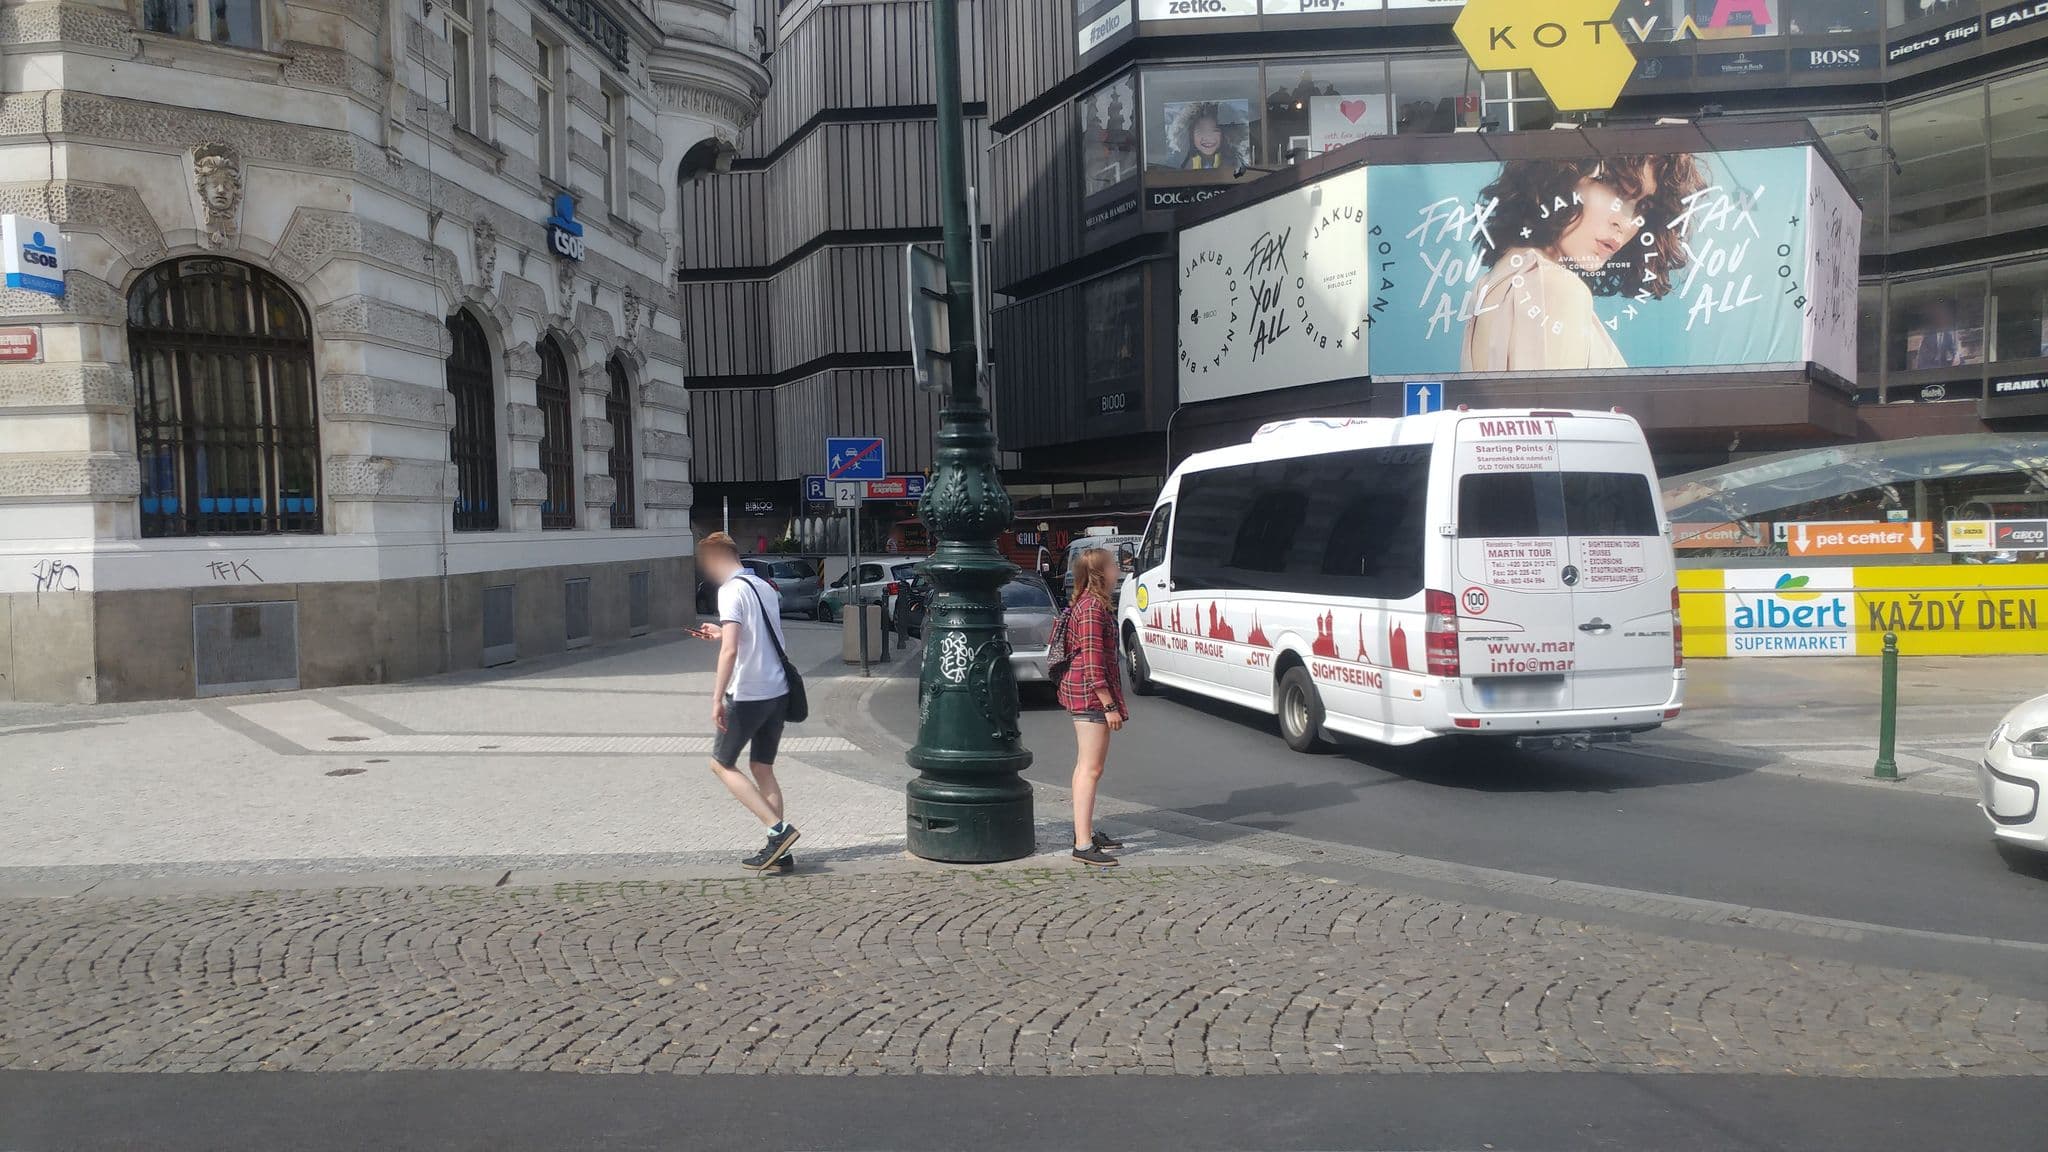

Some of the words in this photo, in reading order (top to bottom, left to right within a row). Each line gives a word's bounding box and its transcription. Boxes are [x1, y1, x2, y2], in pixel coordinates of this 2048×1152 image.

[1169, 0, 1226, 14] zetko.
[1089, 15, 1120, 45] #zetko
[1890, 36, 1940, 60] pietro
[1944, 23, 1979, 41] filipi
[1810, 49, 1860, 65] BOSS
[1154, 192, 1189, 205] DOLC
[1539, 192, 1624, 219] JAKB
[1666, 184, 1766, 238] FAX
[1313, 206, 1364, 239] JAKUB
[1405, 196, 1499, 249] FAX
[23, 248, 58, 269] ČSOB
[1243, 226, 1291, 281] FAX
[1419, 247, 1487, 309] YOU
[1679, 238, 1751, 300] YOU
[1185, 250, 1223, 278] JAKUB
[1213, 264, 1238, 367] POLANKA
[1249, 276, 1284, 335] YOU
[1296, 277, 1328, 349] BIBLOO
[1425, 284, 1500, 340] ALL
[1685, 274, 1763, 332] ALL
[1252, 308, 1290, 362] ALL
[1996, 379, 2039, 392] FRANK
[1479, 420, 1542, 437] MARTIN
[1545, 420, 1554, 435] T
[1475, 445, 1513, 453] Starting
[1515, 444, 1544, 452] Points
[1680, 531, 1702, 541] pet
[1817, 531, 1844, 548] pet
[1848, 530, 1904, 546] center
[2012, 530, 2044, 540] GECO
[1488, 549, 1525, 558] MARTIN
[1528, 549, 1552, 557] TOUR
[1466, 592, 1485, 606] 100
[1734, 598, 1848, 629] albert
[1869, 593, 1966, 632] KAŽDÝ
[1978, 598, 2038, 631] DEN
[1488, 641, 1575, 655] www.mar
[1734, 636, 1848, 650] SUPERMARKET
[1145, 632, 1167, 645] MARTIN
[1171, 637, 1188, 651] TOUR
[1195, 641, 1224, 658] PRAGUE
[1251, 651, 1271, 667] CITY
[1312, 662, 1383, 689] SIGHTSEEING
[1491, 657, 1574, 673] info@mar
